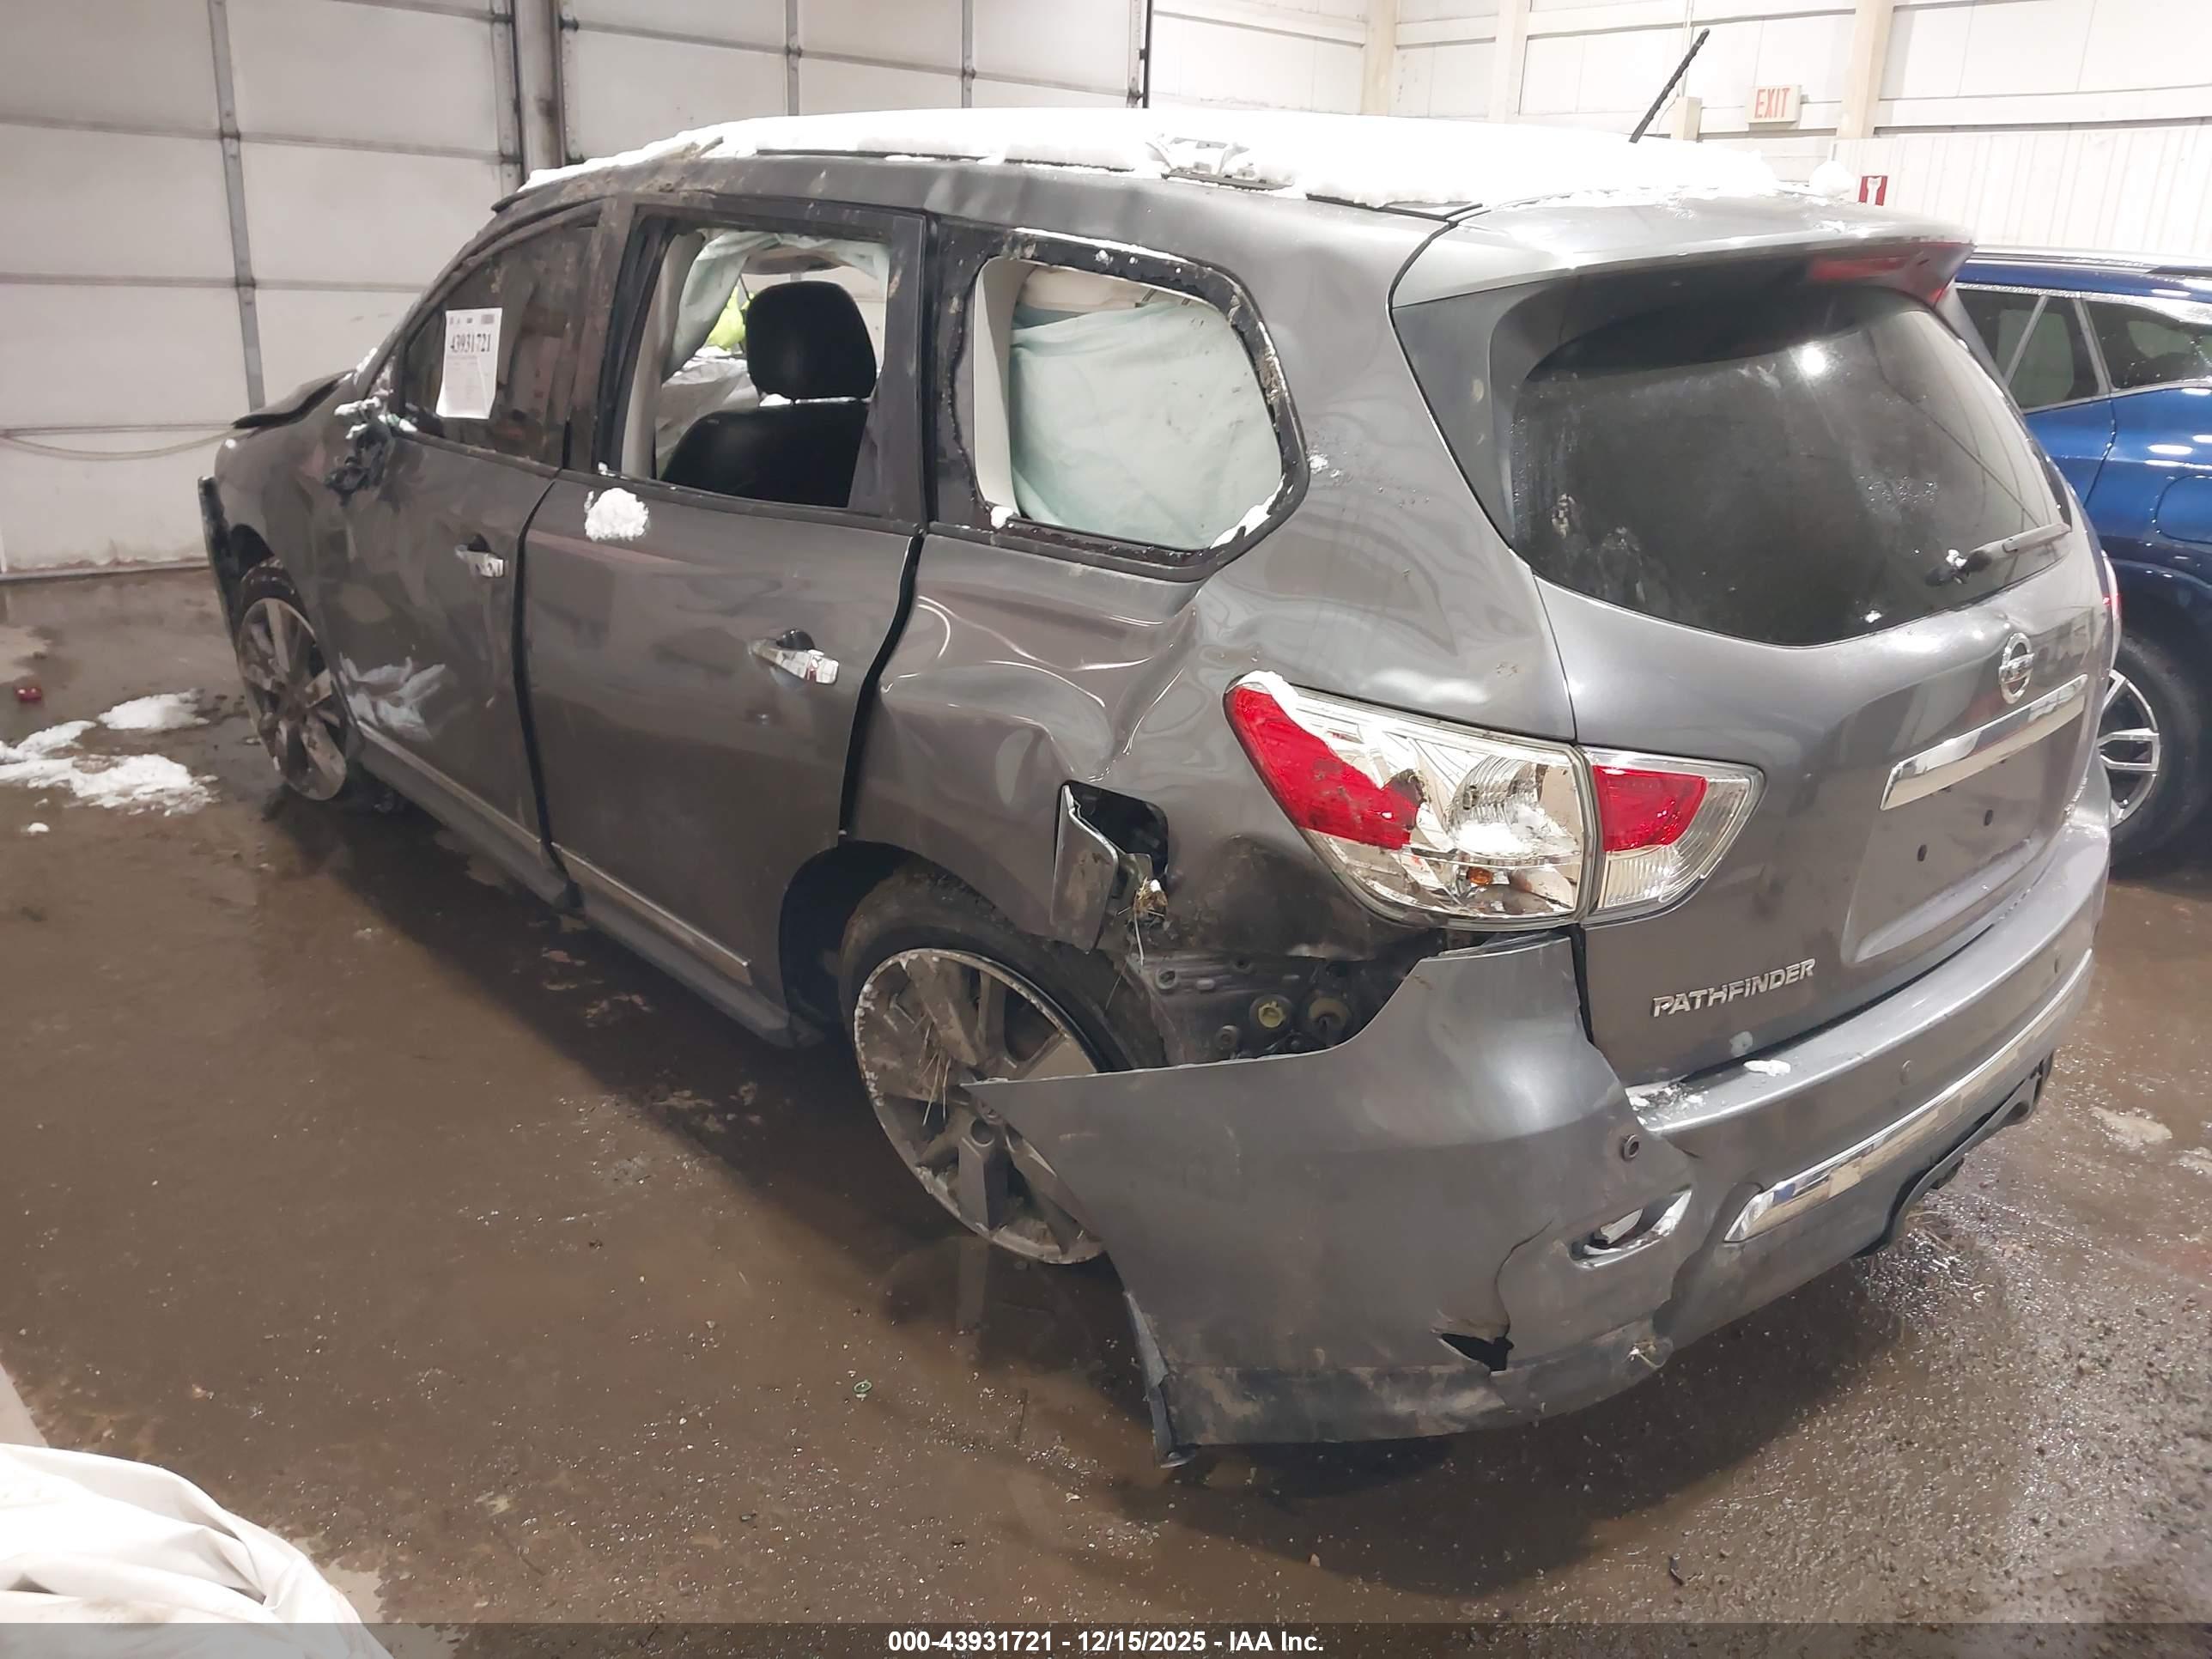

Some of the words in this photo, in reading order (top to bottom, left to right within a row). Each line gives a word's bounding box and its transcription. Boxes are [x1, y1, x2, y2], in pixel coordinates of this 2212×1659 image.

[1754, 88, 1790, 118] EXIT
[450, 333, 491, 352] 43931721
[1652, 958, 1815, 1018] PATHFINDER
